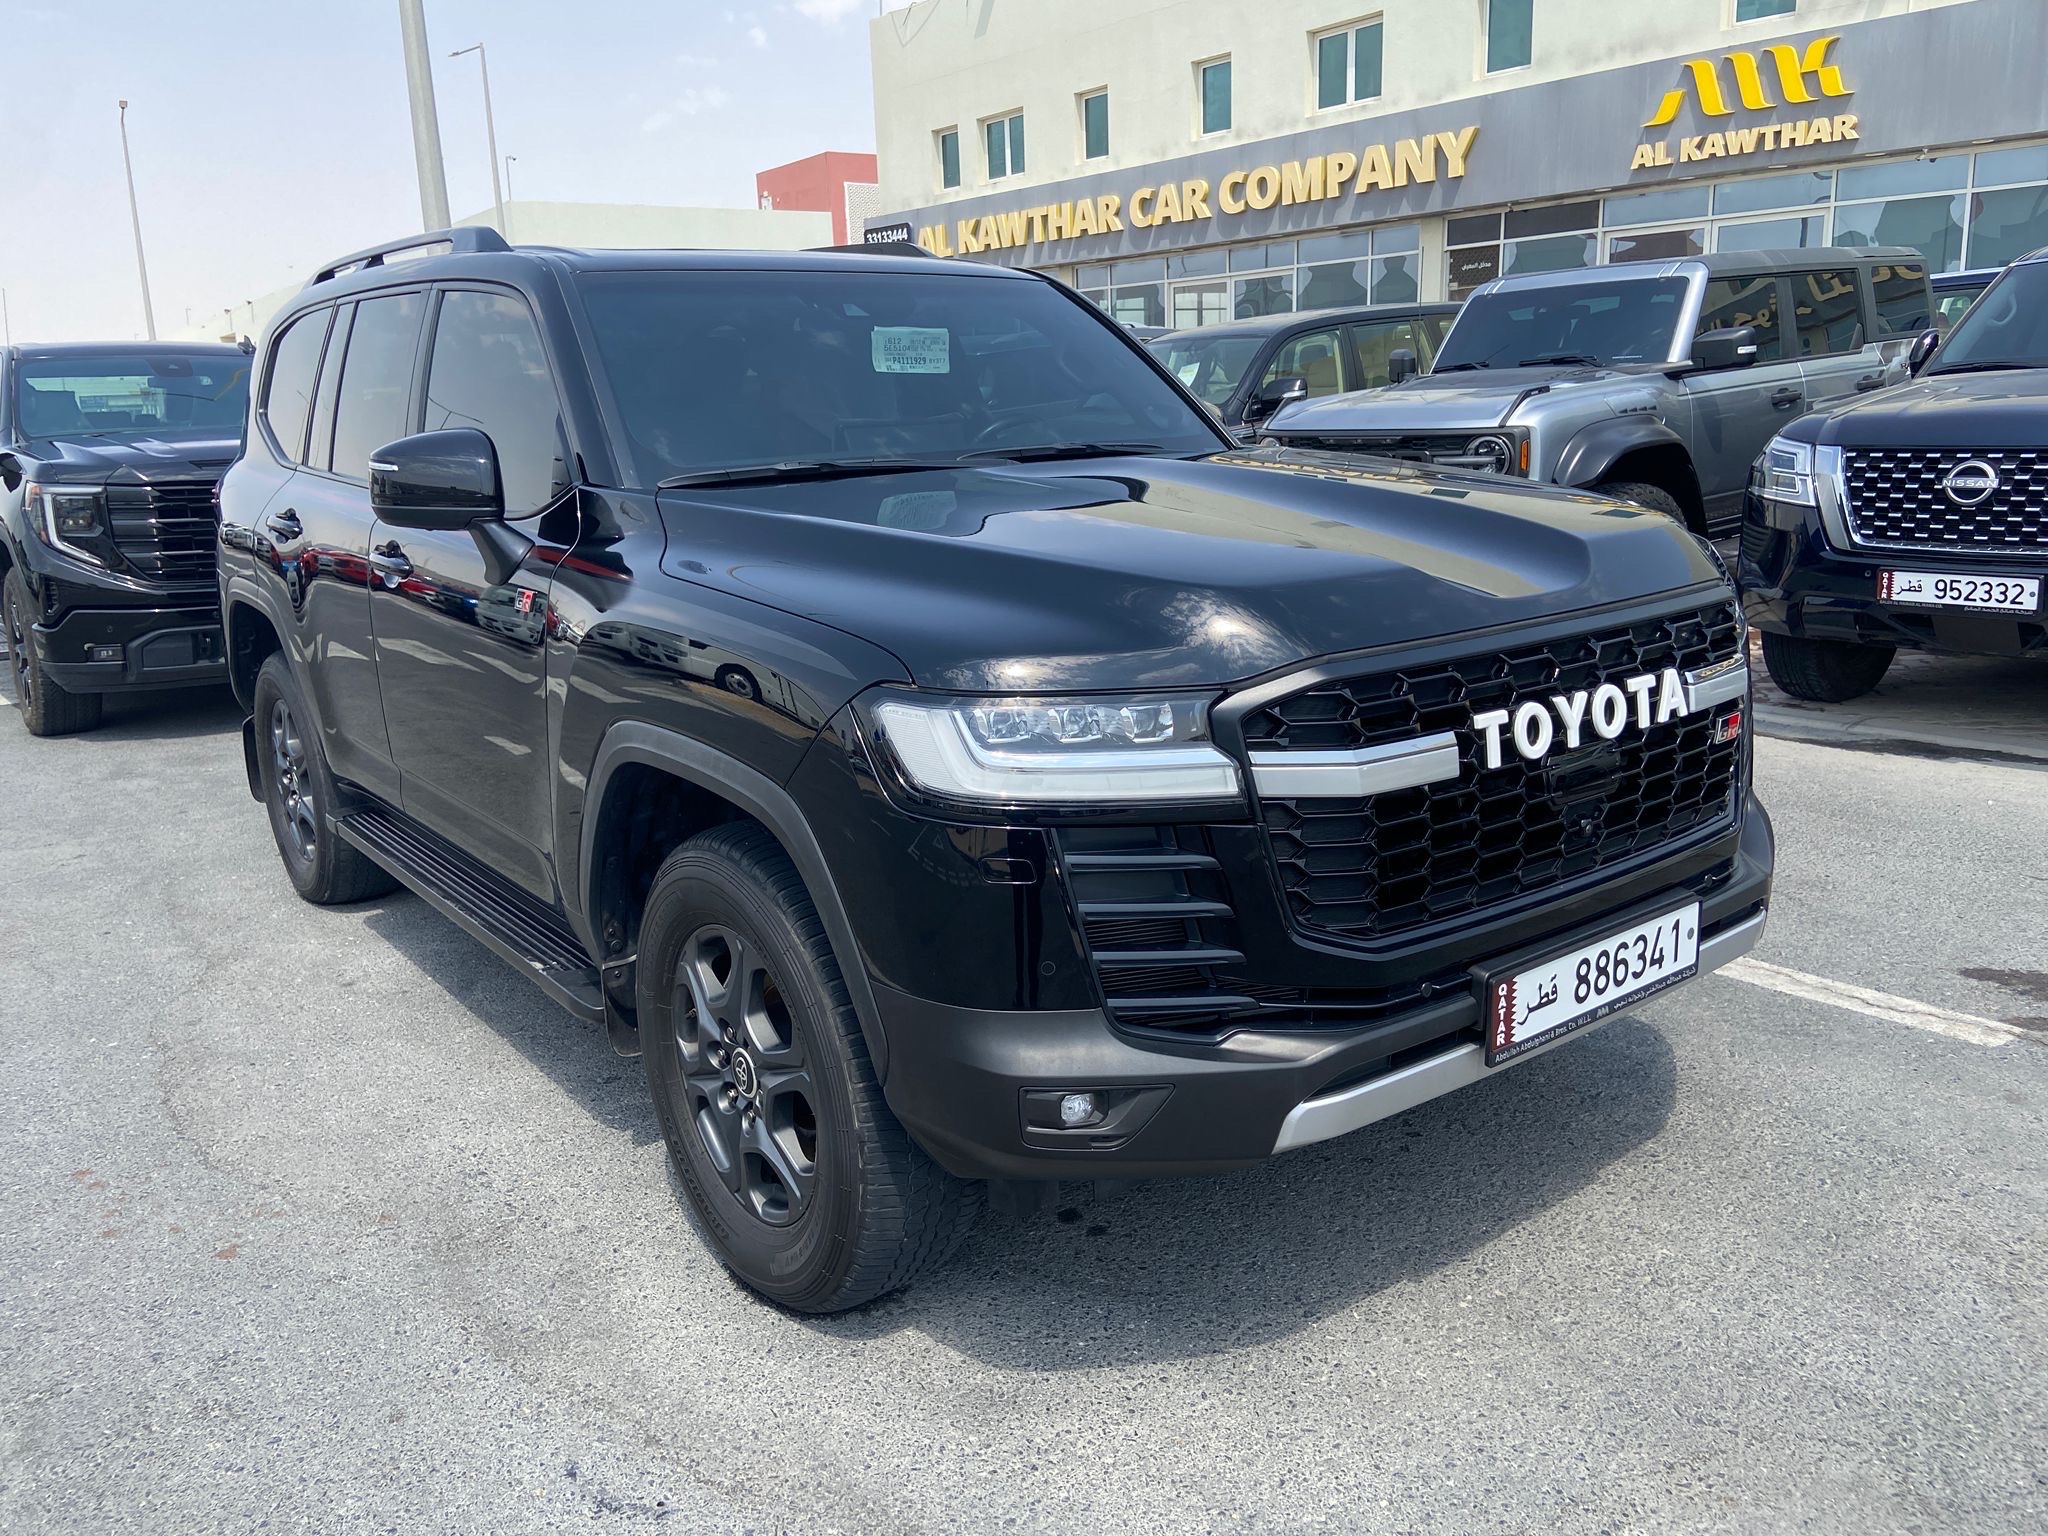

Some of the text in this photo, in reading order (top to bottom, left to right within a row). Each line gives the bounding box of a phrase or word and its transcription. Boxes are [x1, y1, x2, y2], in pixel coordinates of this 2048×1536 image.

[1630, 114, 1861, 171] AL KAWTHAR
[918, 126, 1480, 258] AL KAWTHAR CAR COMPANY
[866, 227, 909, 244] 33133444
[1942, 478, 1997, 487] NISSAN
[1881, 572, 1889, 599] QATAR
[1895, 579, 1923, 595] قطر
[1934, 578, 2026, 606] 952332
[1474, 668, 1689, 769] TOYOTA
[1573, 917, 1681, 1005] 886341
[1495, 983, 1508, 1047] QATAR
[1516, 973, 1559, 1026] قطر
